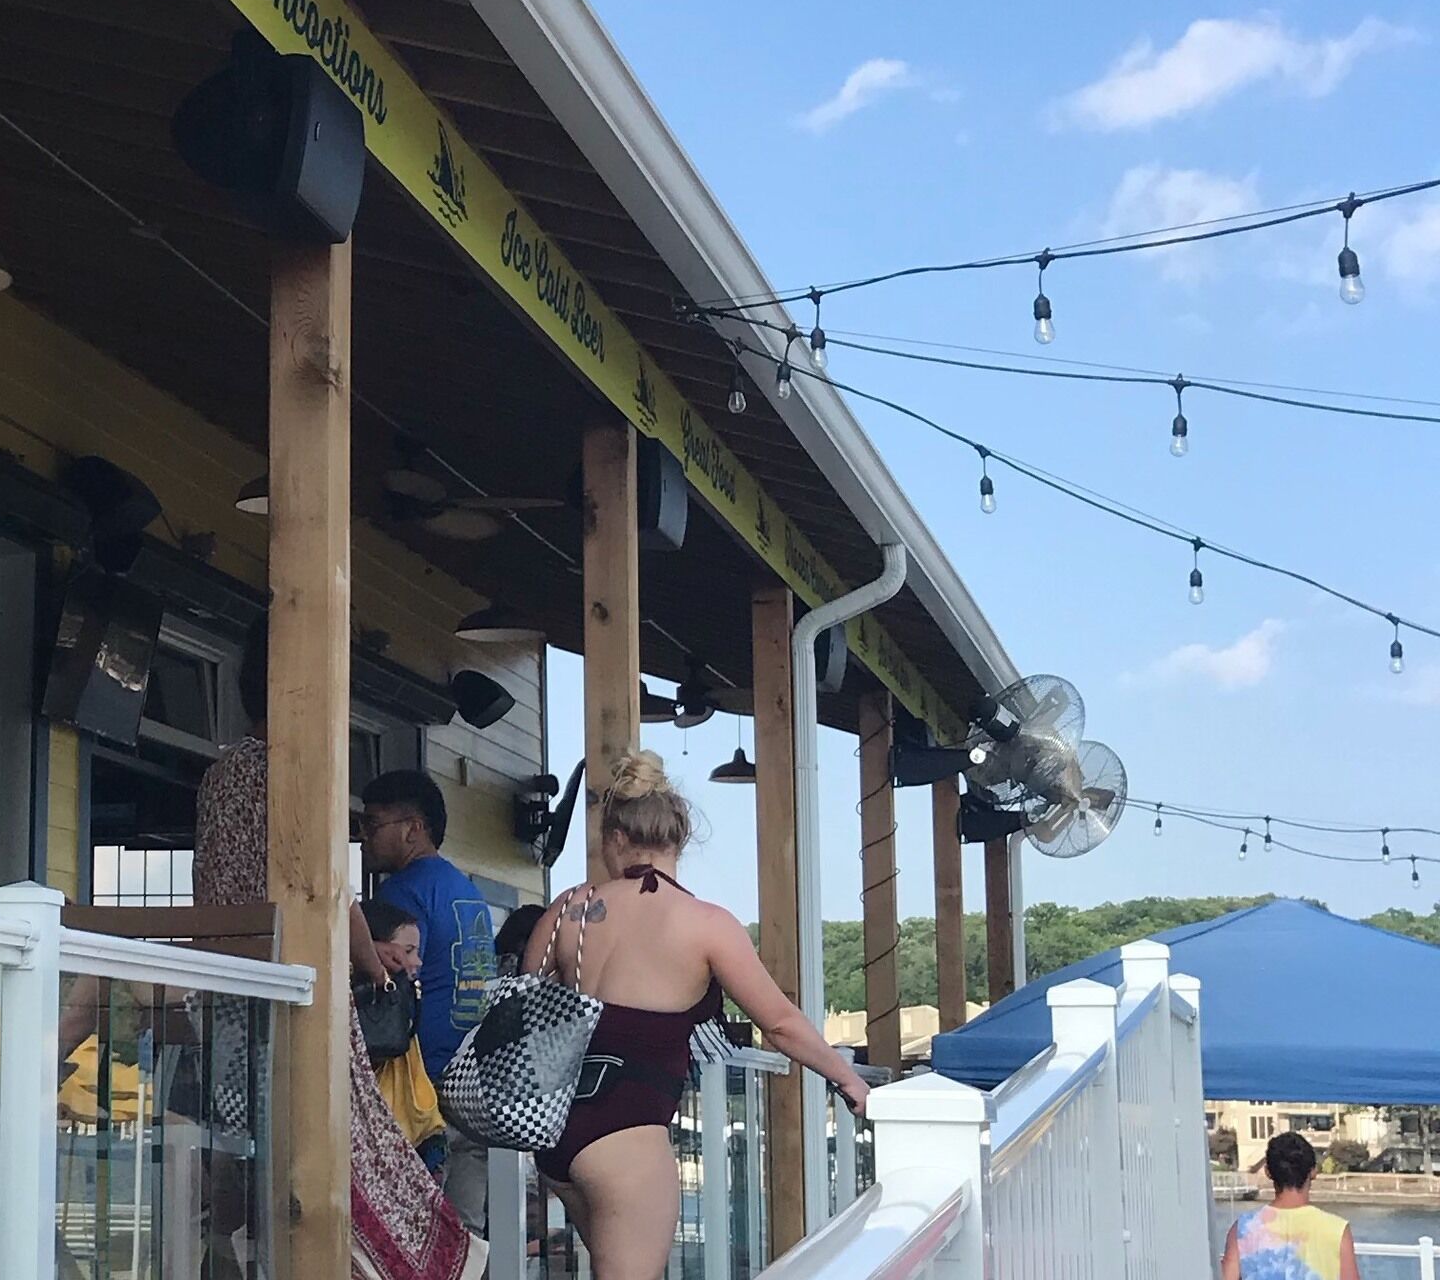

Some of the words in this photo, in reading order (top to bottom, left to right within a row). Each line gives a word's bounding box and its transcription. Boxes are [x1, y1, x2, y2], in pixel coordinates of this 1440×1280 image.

[501, 208, 533, 282] Ice
[535, 237, 570, 324] Cold
[570, 281, 605, 364] Beer
